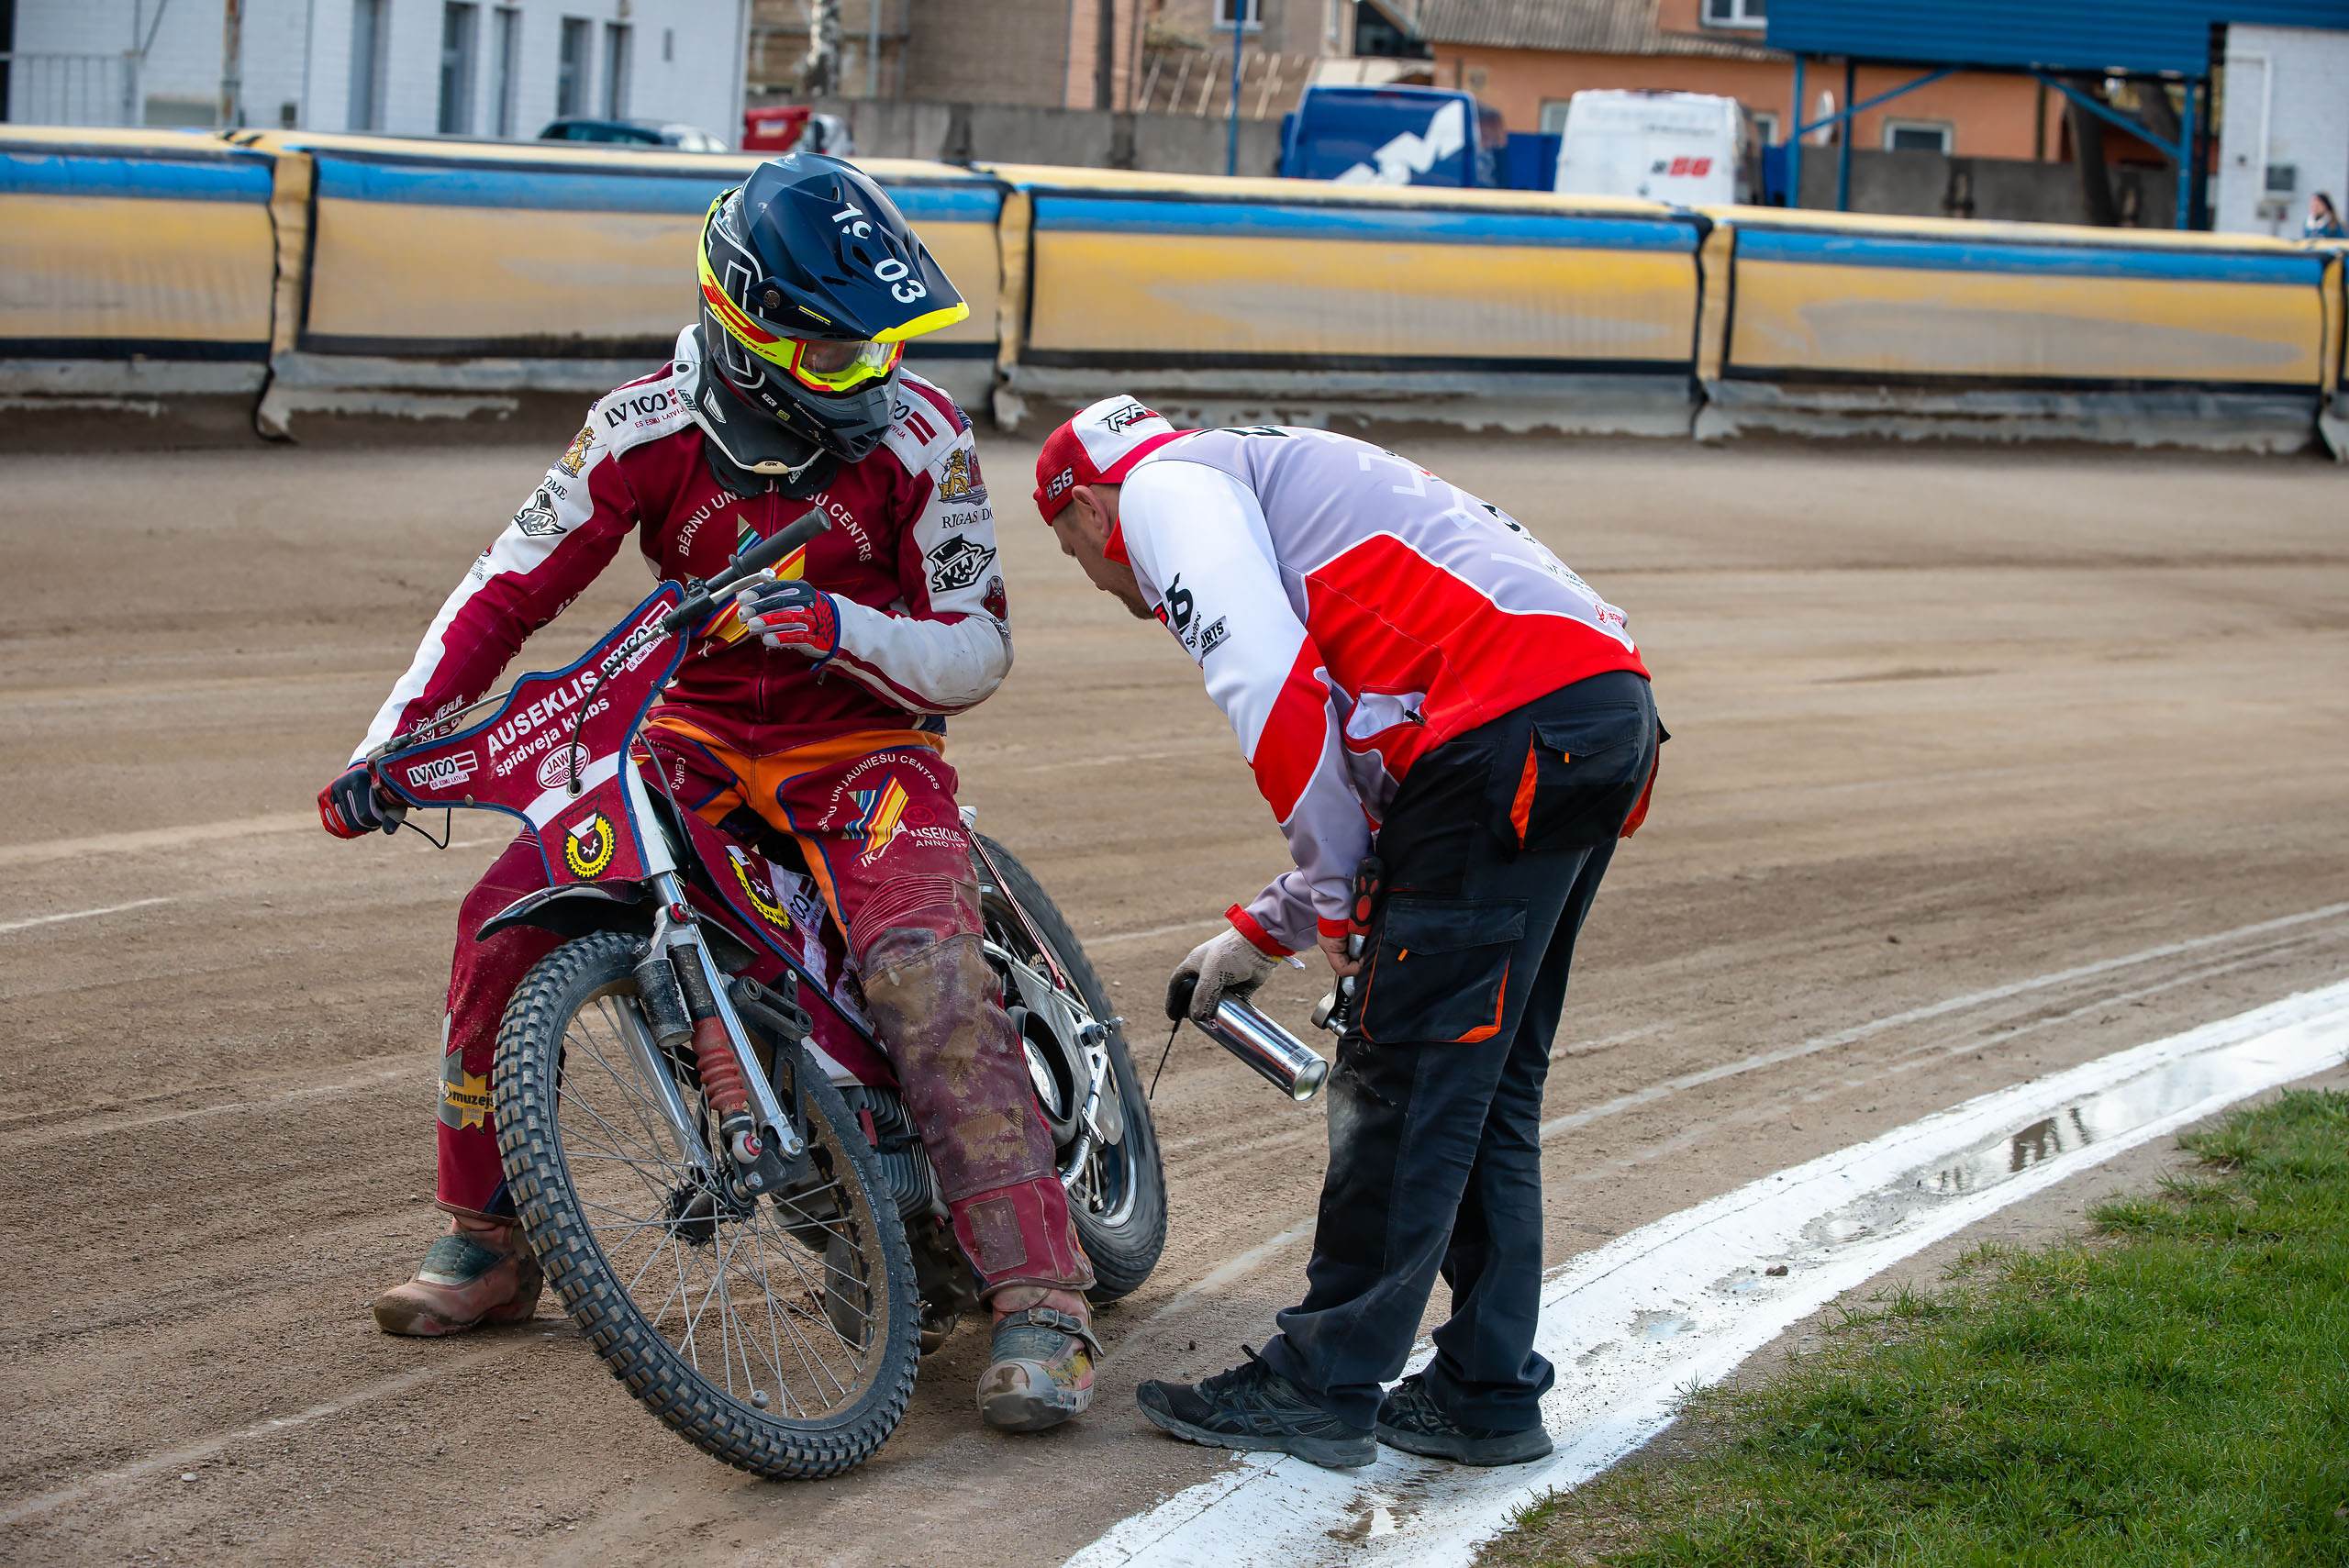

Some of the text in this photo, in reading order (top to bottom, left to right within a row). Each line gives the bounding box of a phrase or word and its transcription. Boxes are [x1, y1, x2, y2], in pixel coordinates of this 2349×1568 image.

[662, 406, 685, 420] LATVIJ
[543, 475, 568, 500] OME
[1047, 466, 1074, 502] #56
[678, 506, 711, 557] BĒRNU
[830, 503, 872, 562] CENTRS
[487, 671, 599, 758] AUSEKLIS
[546, 749, 575, 775] JAW
[831, 786, 843, 802] UN
[841, 753, 896, 787] JAUNIEŠU
[900, 755, 940, 790] CENTRS
[916, 840, 949, 849] ANNO
